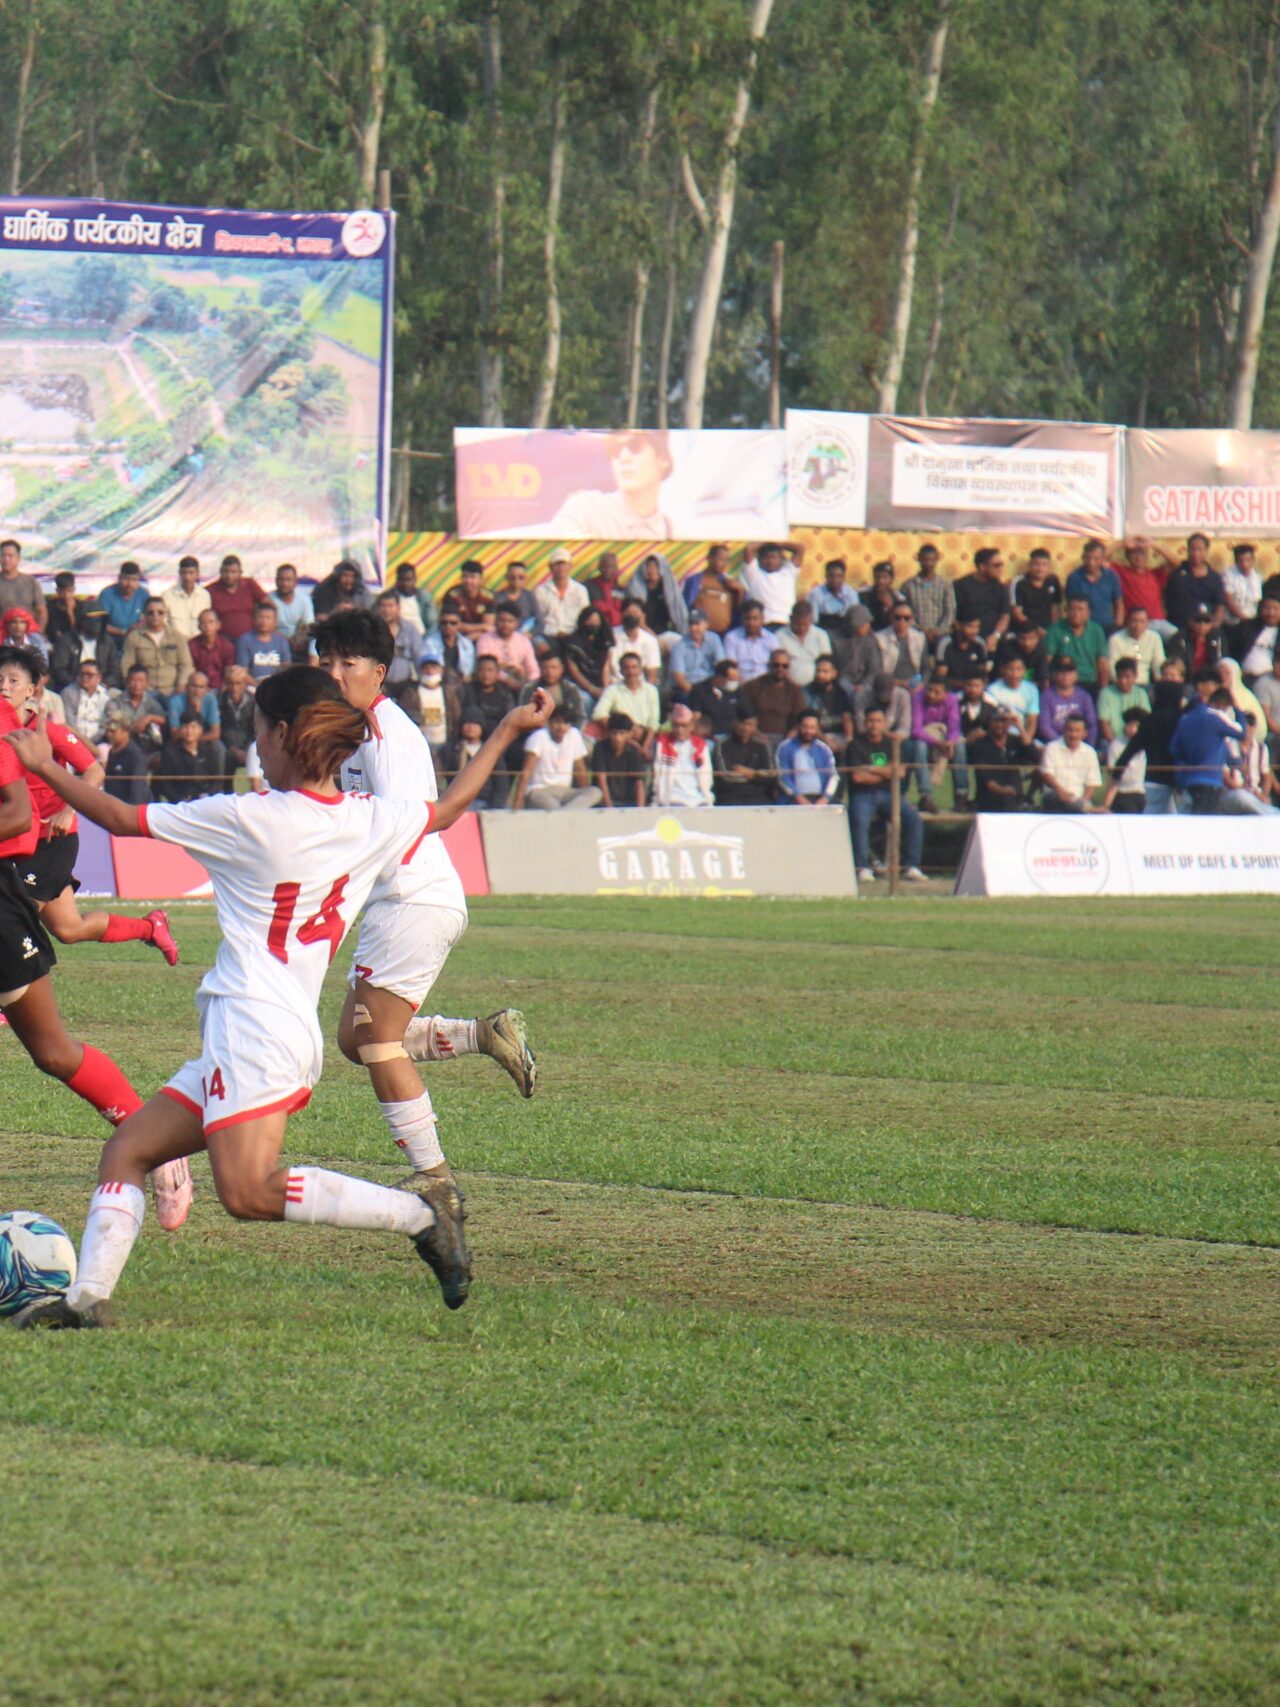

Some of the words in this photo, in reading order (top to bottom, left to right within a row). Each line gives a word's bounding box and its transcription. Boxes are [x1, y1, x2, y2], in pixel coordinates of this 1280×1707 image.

[1146, 487, 1280, 524] SATAKSHI
[599, 849, 746, 880] GARAGE
[1143, 854, 1175, 869] MEET
[267, 873, 350, 966] 14
